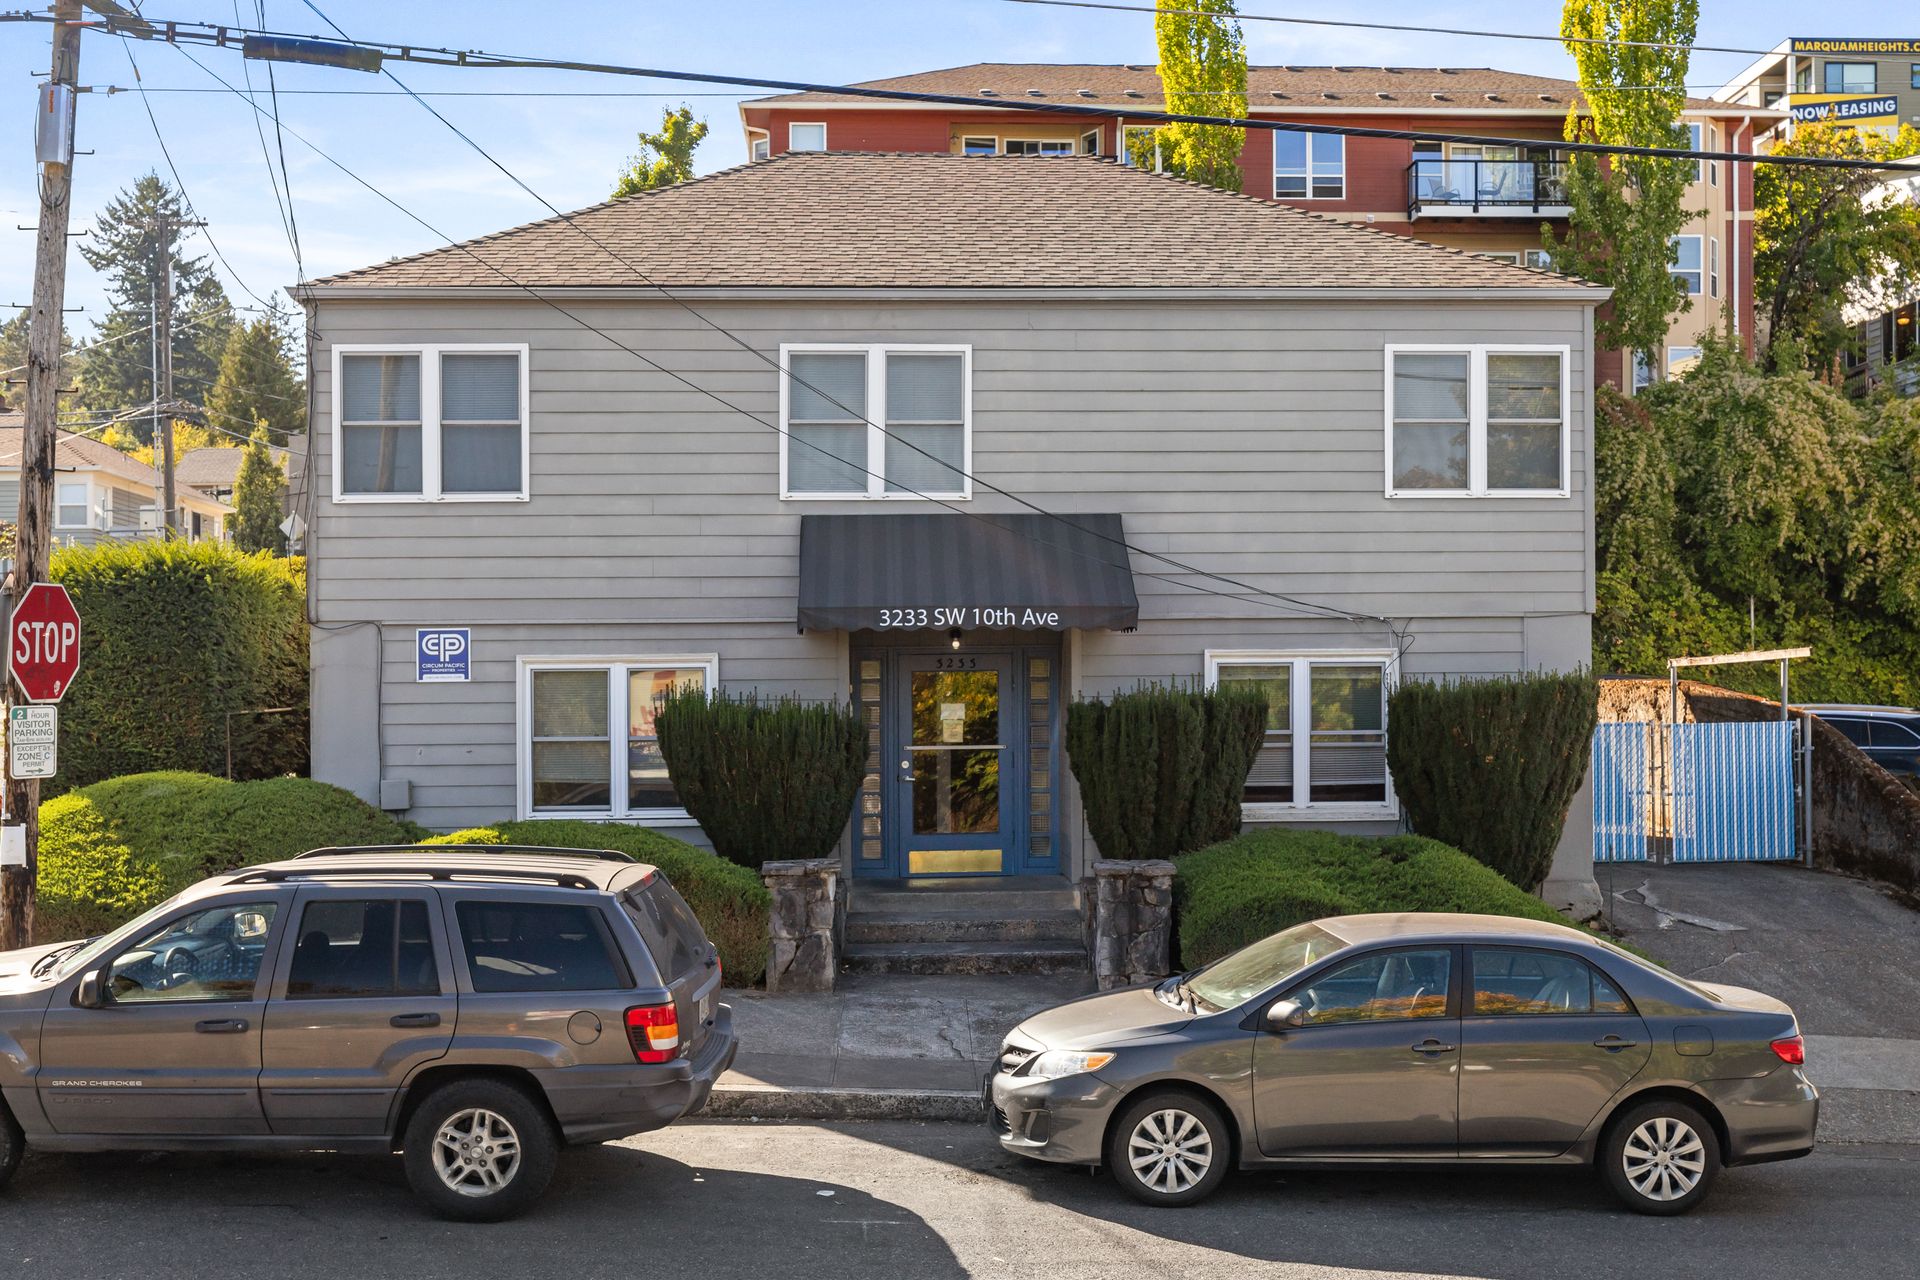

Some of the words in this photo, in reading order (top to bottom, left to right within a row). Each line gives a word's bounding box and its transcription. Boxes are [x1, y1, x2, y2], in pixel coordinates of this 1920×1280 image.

[1792, 105, 1830, 120] NOW
[1836, 100, 1896, 116] LEASING
[879, 609, 928, 626] 3233
[934, 608, 966, 625] SW
[972, 607, 1016, 626] 10th
[1022, 608, 1059, 626] Ave
[15, 621, 76, 664] STOP
[16, 710, 24, 720] 2
[16, 720, 51, 728] VISITOR
[14, 728, 54, 737] PARKING
[17, 752, 42, 761] ZONE
[44, 751, 51, 760] C
